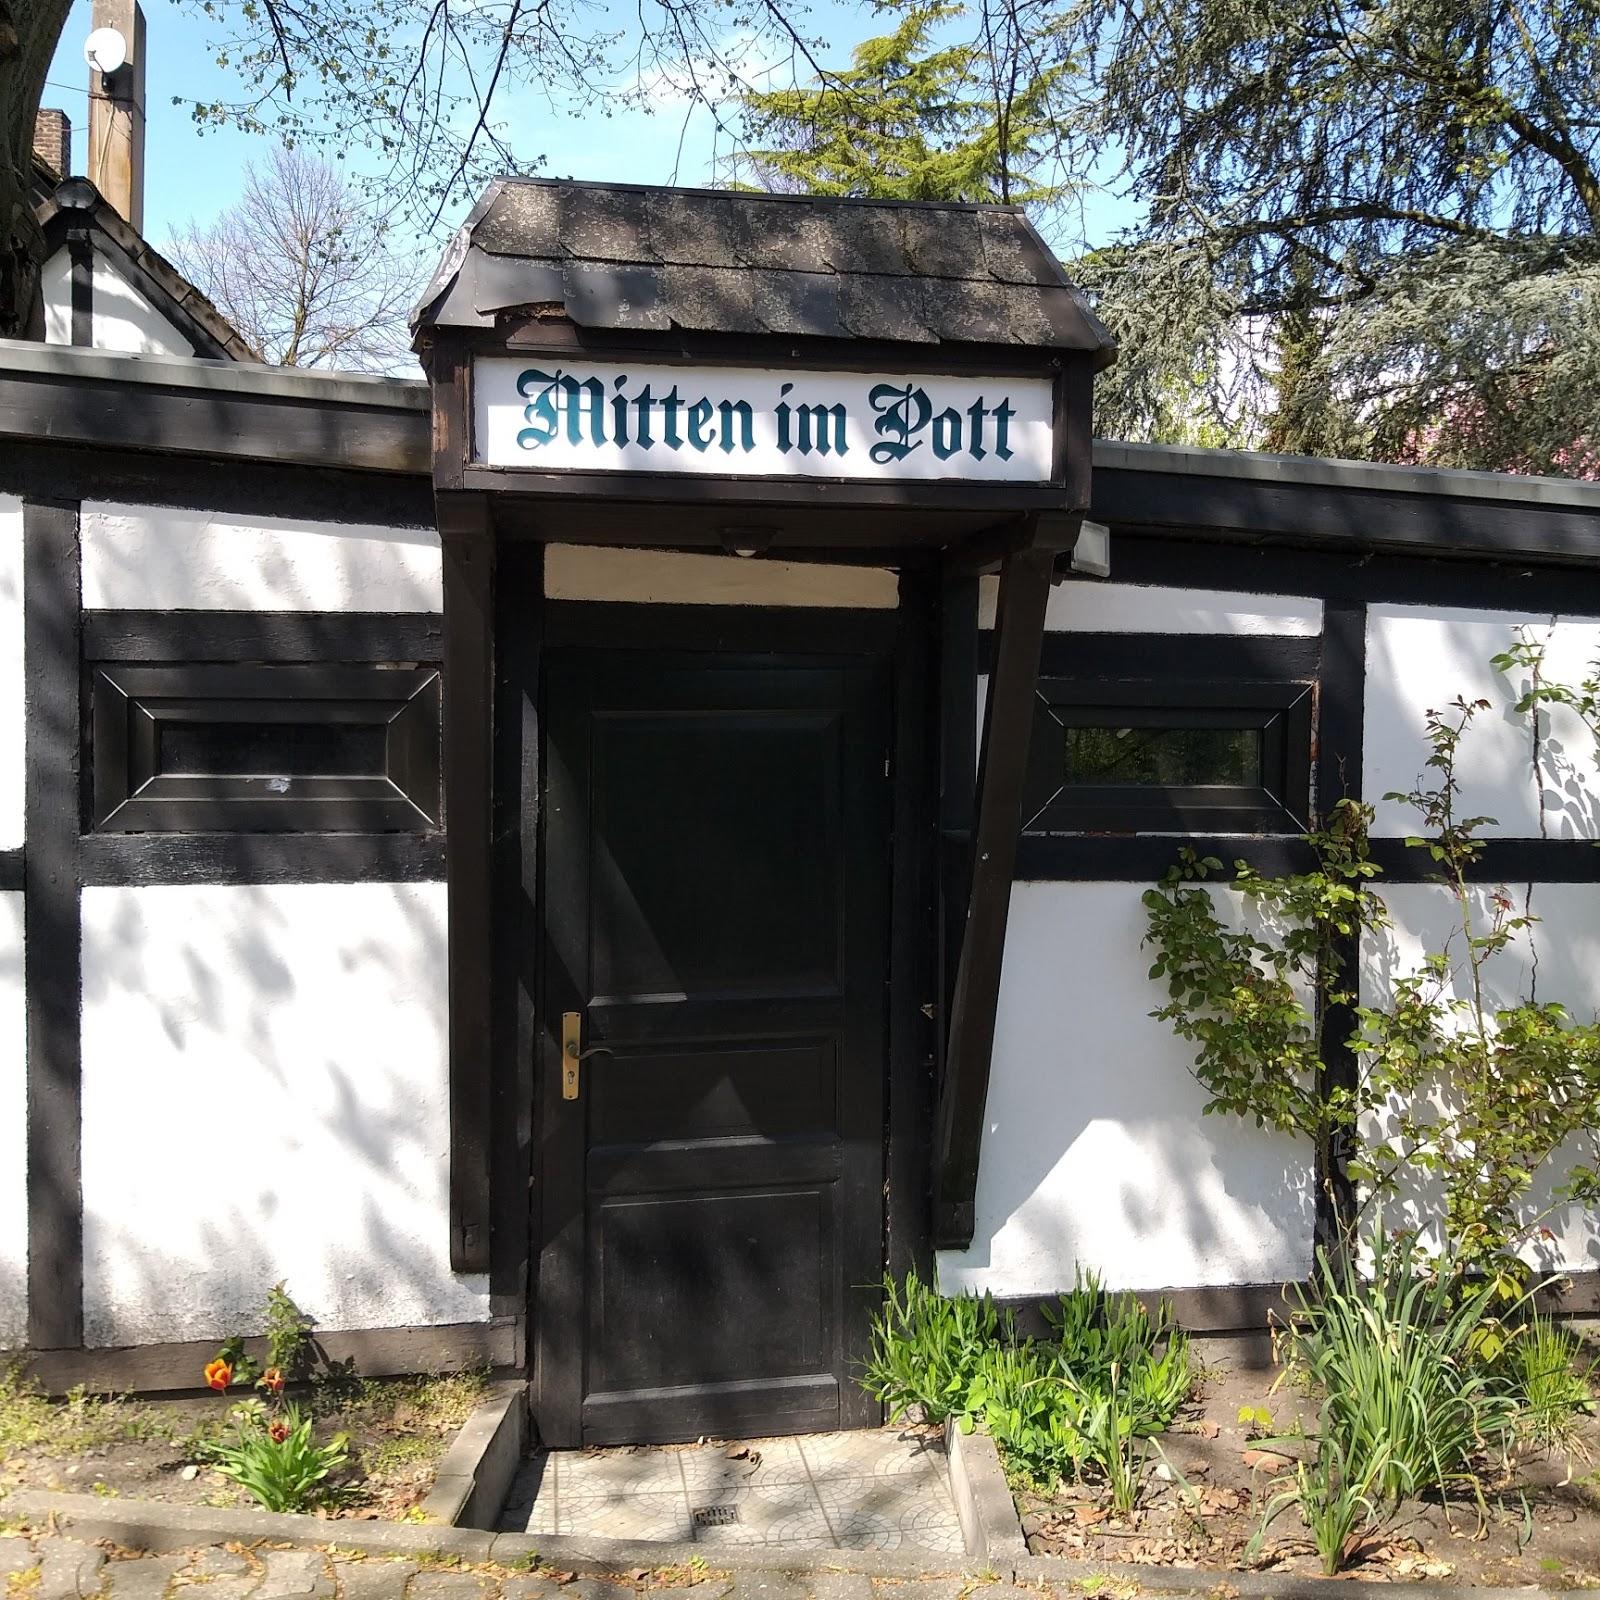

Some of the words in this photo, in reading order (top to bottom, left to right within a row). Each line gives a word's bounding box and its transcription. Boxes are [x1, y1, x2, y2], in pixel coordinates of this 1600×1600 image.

[517, 369, 755, 454] Mitten
[774, 382, 850, 457] im
[868, 382, 1017, 465] Pott
